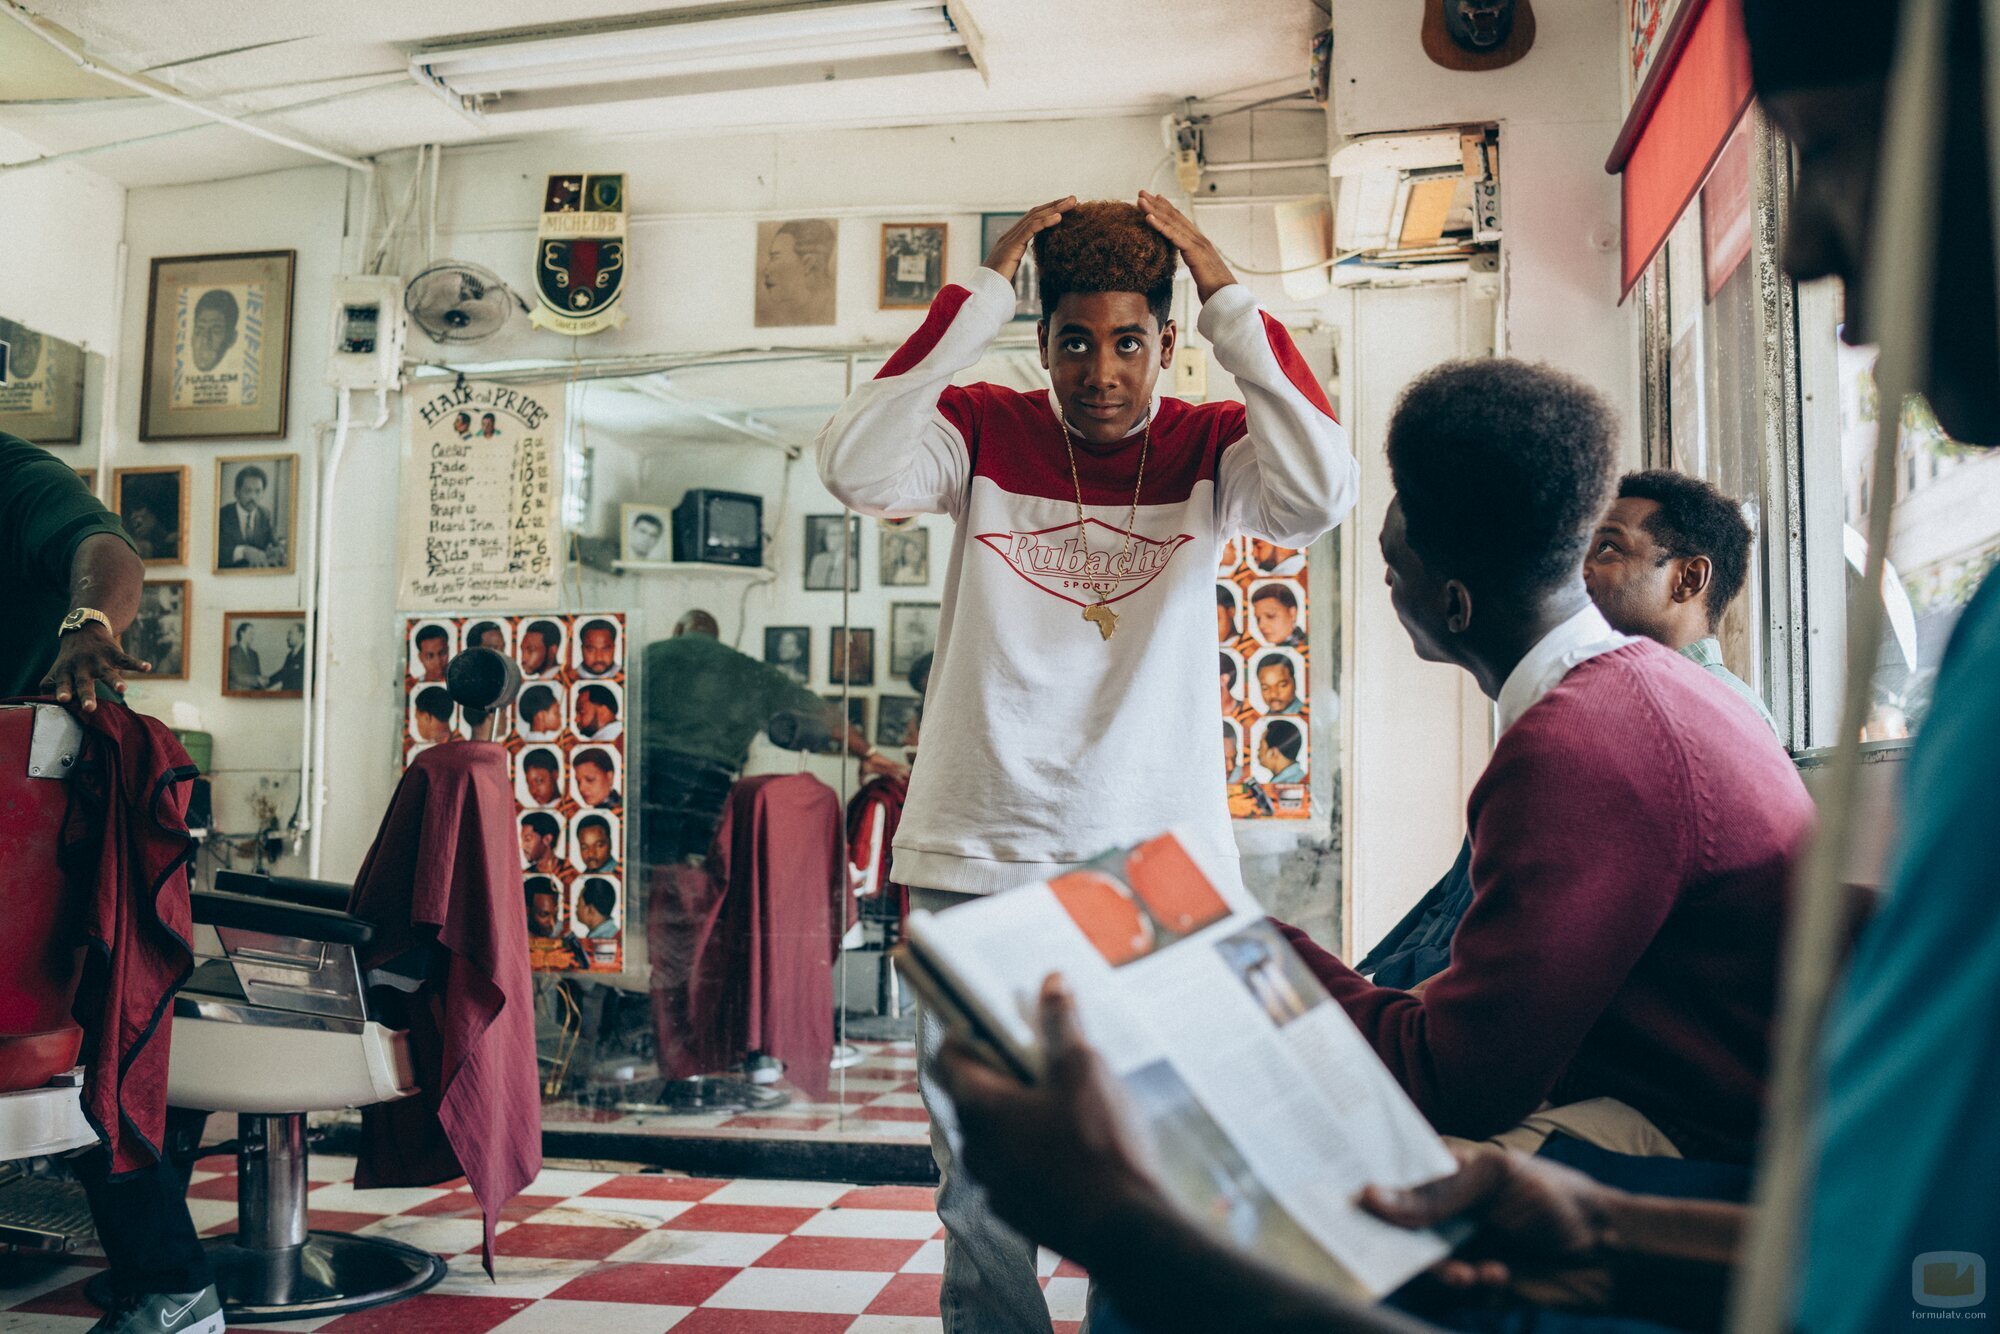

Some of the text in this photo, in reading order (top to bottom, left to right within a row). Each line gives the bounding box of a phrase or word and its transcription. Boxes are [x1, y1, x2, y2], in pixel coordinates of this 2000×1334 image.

[546, 214, 617, 232] MICHELOB
[420, 384, 474, 426] HAIR
[493, 387, 549, 430] PRICES
[430, 460, 466, 474] Fade
[429, 474, 475, 488] Taper
[426, 549, 469, 564] Kids
[1063, 580, 1111, 591] SPORT
